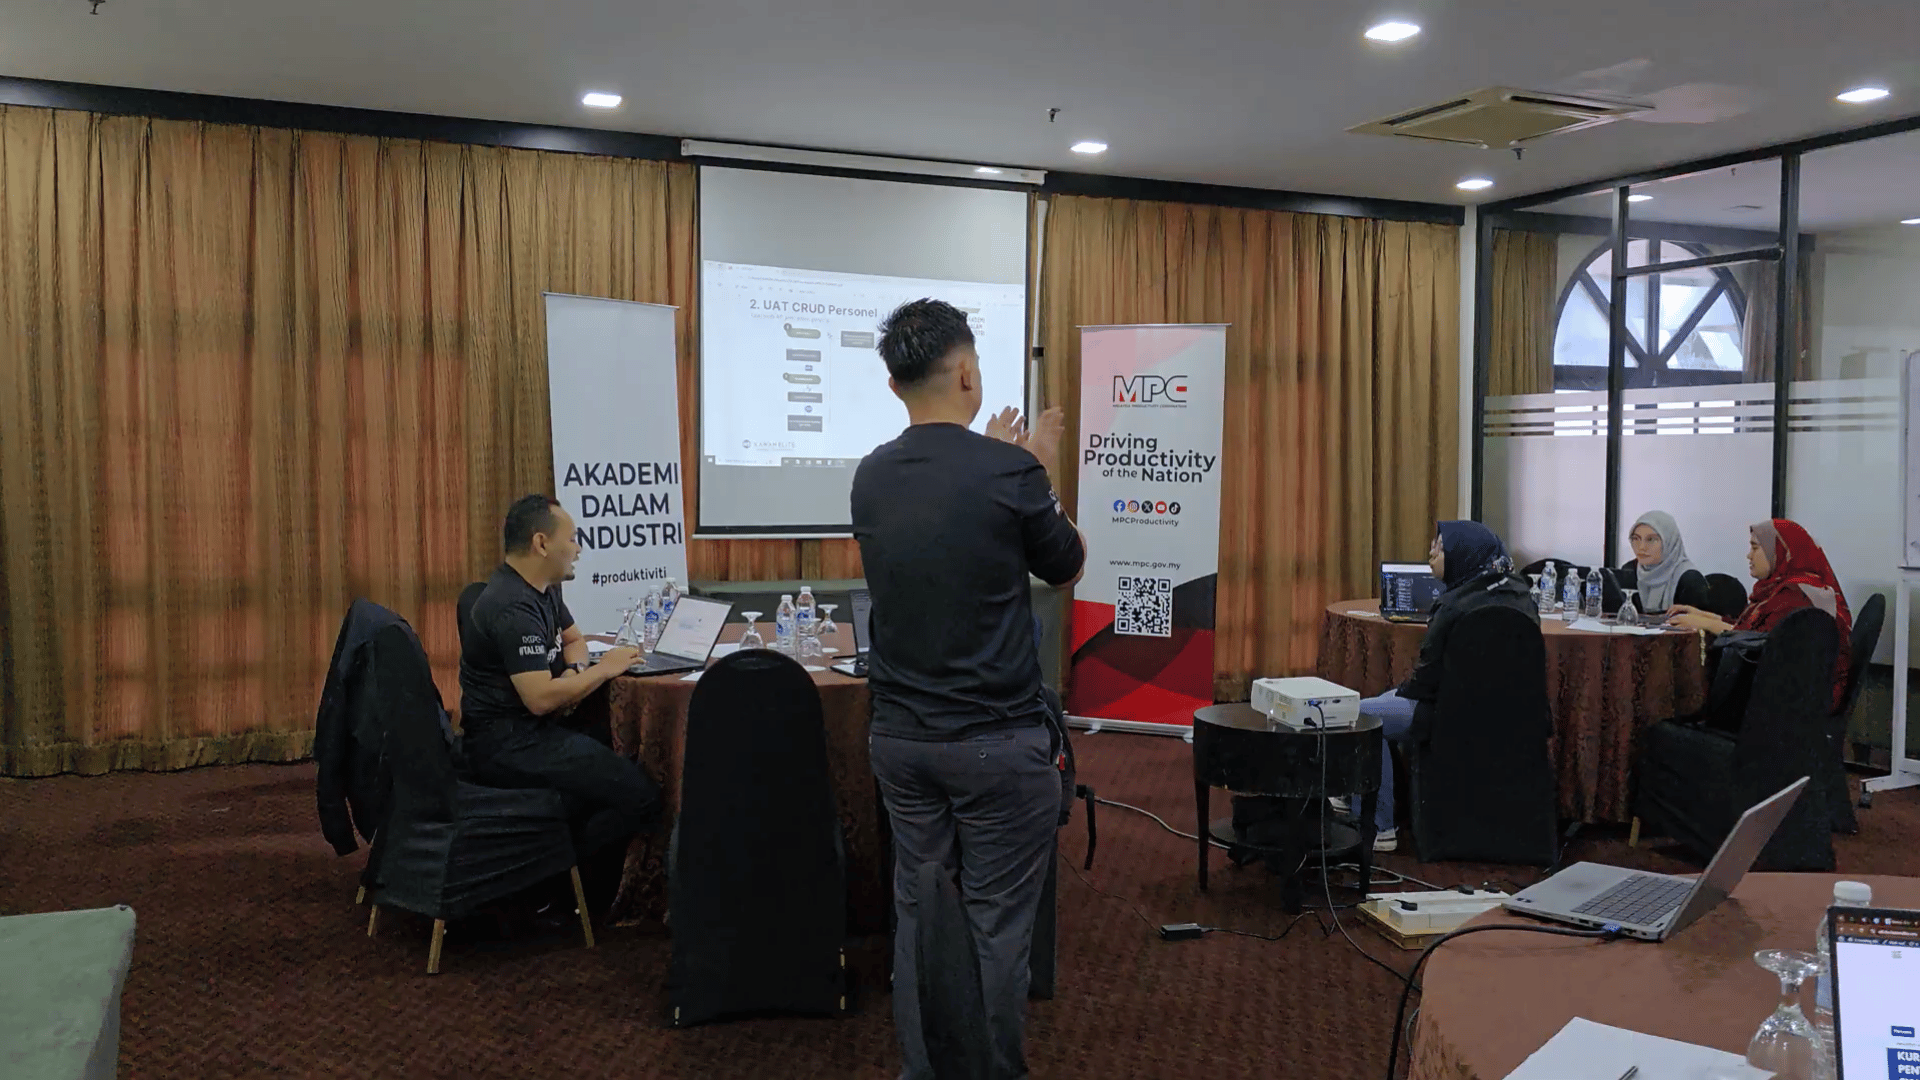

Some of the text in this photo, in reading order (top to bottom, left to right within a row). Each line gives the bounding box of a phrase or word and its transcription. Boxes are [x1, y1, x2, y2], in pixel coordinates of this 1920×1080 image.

[749, 298, 760, 310] 2.
[763, 299, 789, 311] UAT
[792, 302, 826, 314] CRUD
[828, 304, 878, 318] Personel
[1112, 374, 1188, 403] MPC
[1089, 433, 1158, 453] Driving
[1084, 449, 1216, 472] Productivity
[563, 462, 679, 487] AKADEMI
[1102, 466, 1203, 483] of the Nation
[581, 492, 670, 518] DALAM
[1111, 516, 1179, 527] MPCProductivity
[576, 522, 683, 550] NDUSTRI
[1109, 559, 1182, 570] www.mpc.gov.my
[592, 566, 667, 587] #produktiviti
